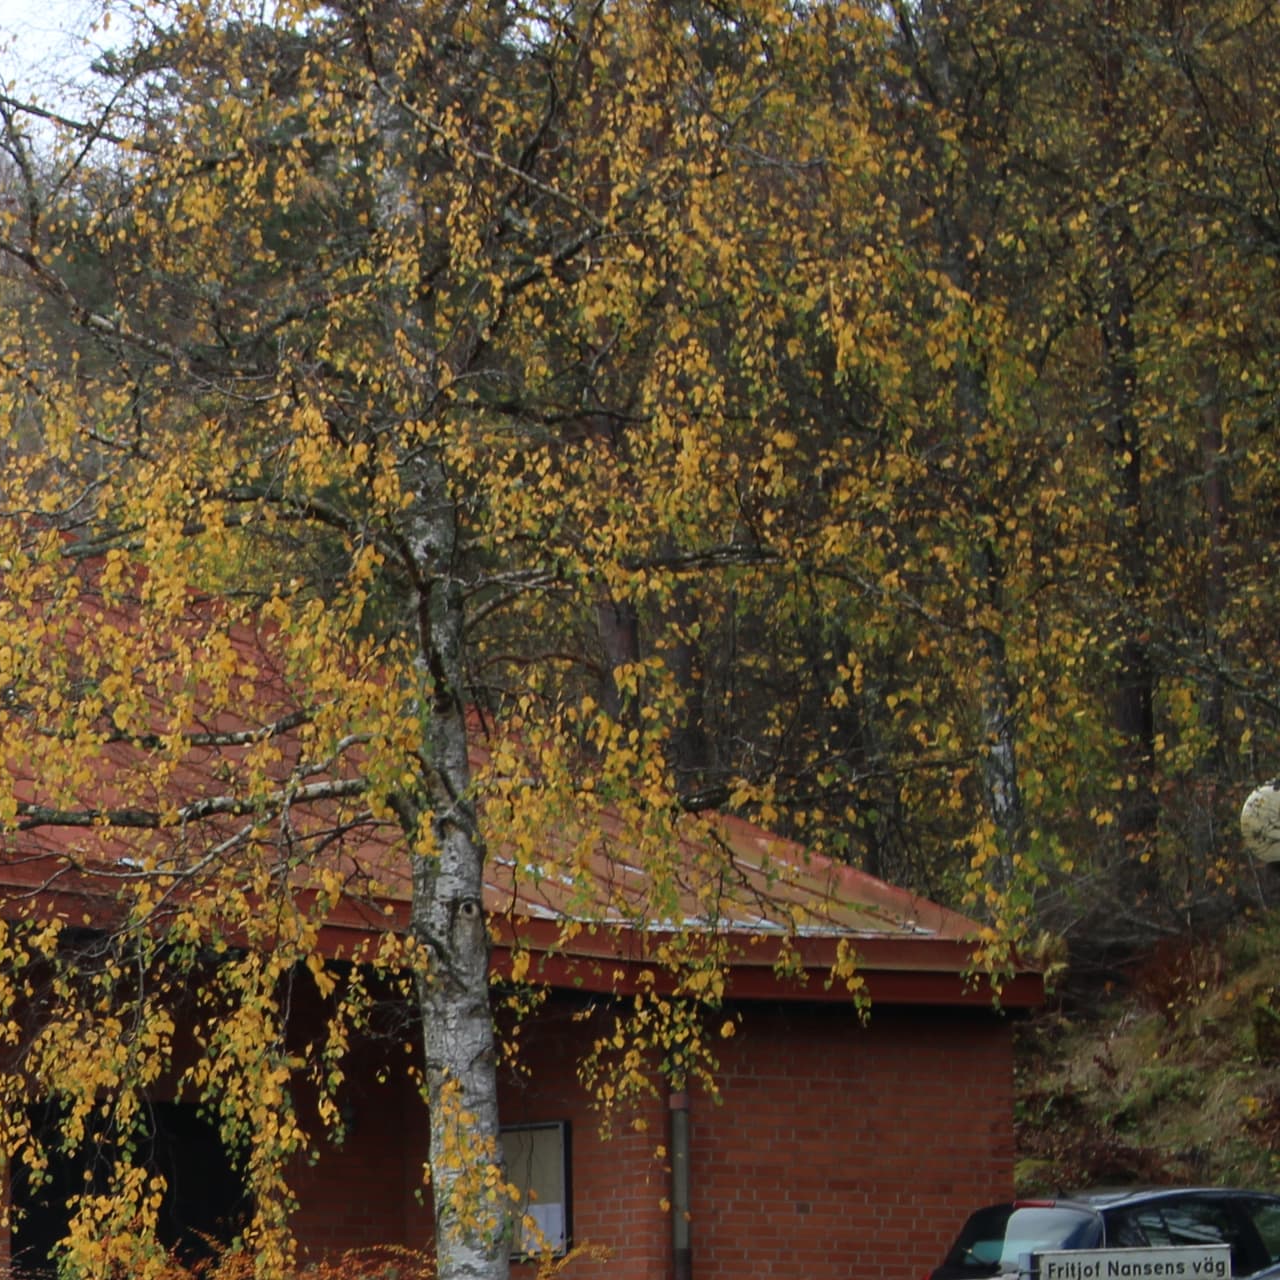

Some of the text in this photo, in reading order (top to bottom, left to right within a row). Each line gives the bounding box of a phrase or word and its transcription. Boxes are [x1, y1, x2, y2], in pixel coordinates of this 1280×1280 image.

[1048, 1257, 1226, 1280] Fritjof Nansens väg
